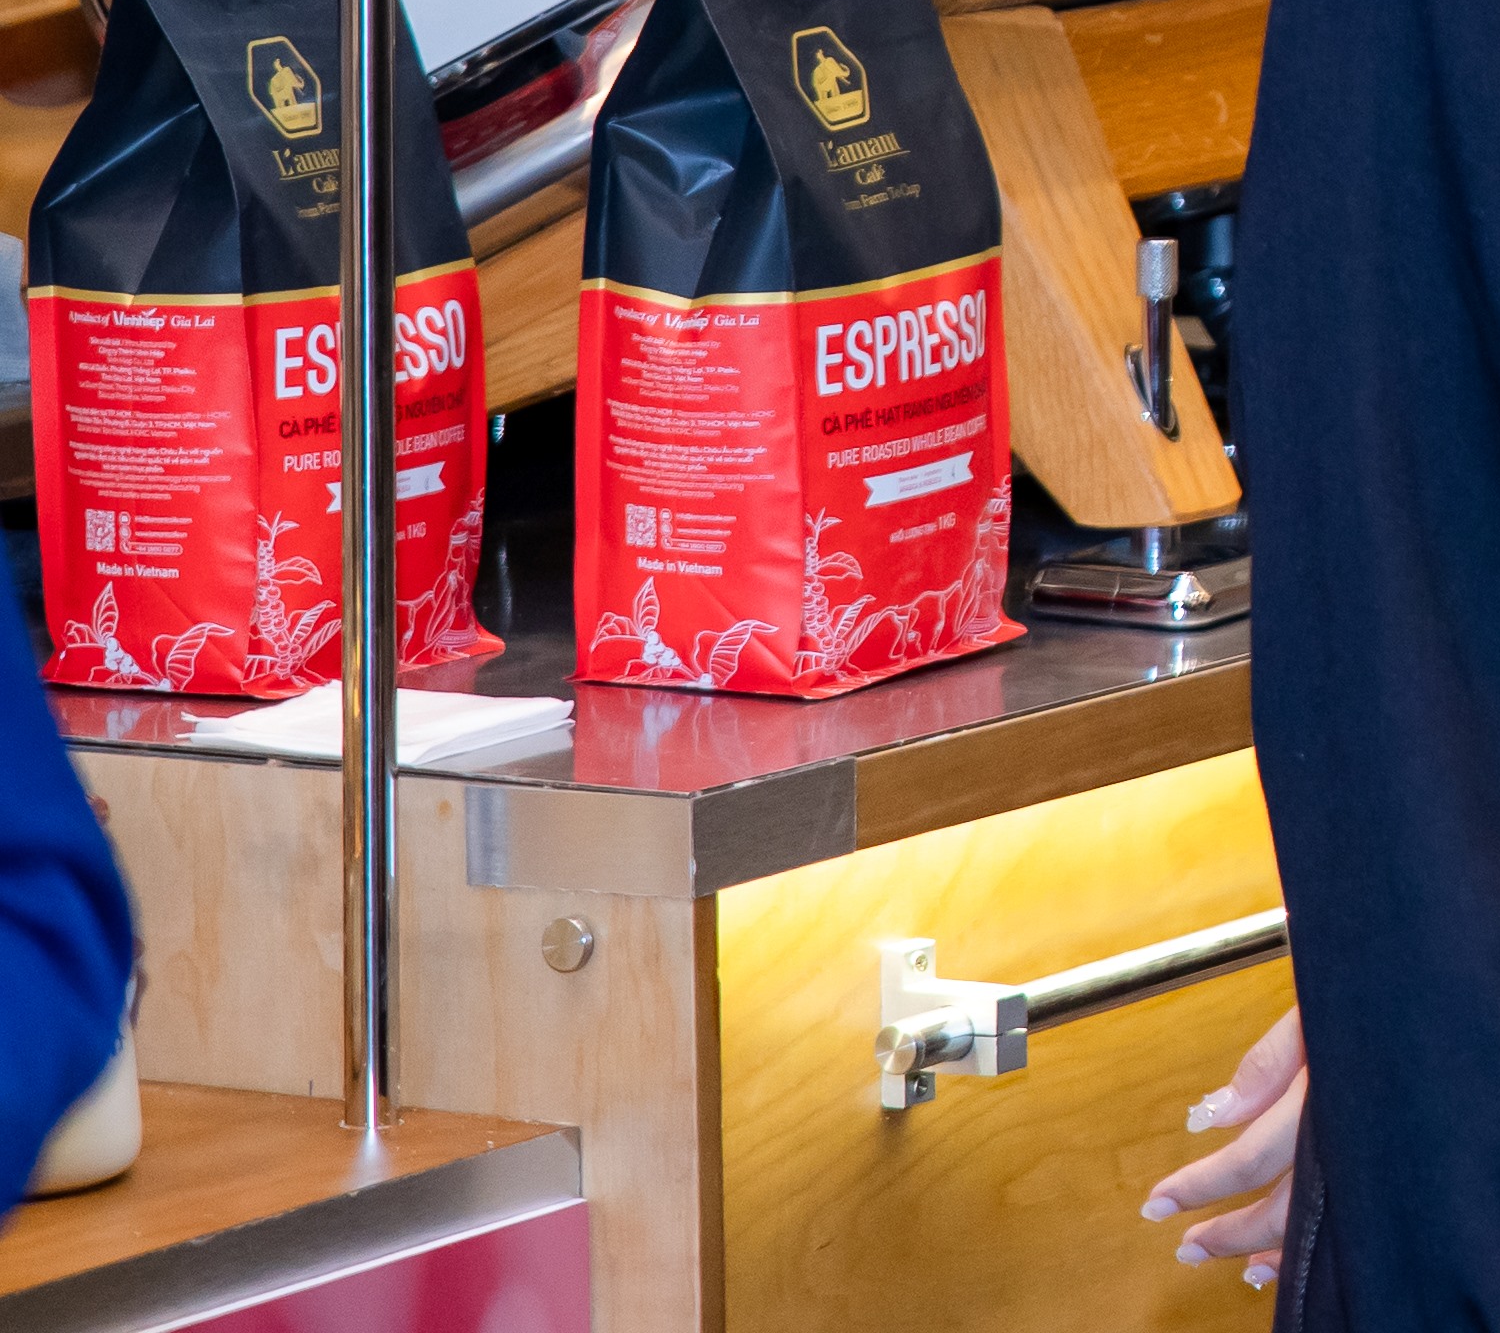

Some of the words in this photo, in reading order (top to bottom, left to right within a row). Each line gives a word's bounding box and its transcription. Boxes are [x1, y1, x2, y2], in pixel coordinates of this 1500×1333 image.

[171, 314, 191, 327] Gia
[195, 315, 215, 328] Lai
[714, 314, 736, 327] Gia
[740, 314, 760, 327] Lai
[816, 289, 987, 397] ESPRESSO
[283, 451, 321, 473] PURE
[828, 448, 860, 469] PURE
[862, 438, 911, 464] ROASTED
[407, 521, 427, 539] 1KG
[97, 561, 122, 576] Made
[124, 563, 135, 576] in
[135, 564, 179, 579] Vietnam
[637, 556, 665, 572] Made
[666, 559, 677, 572] in
[677, 560, 723, 576] Vietnam
